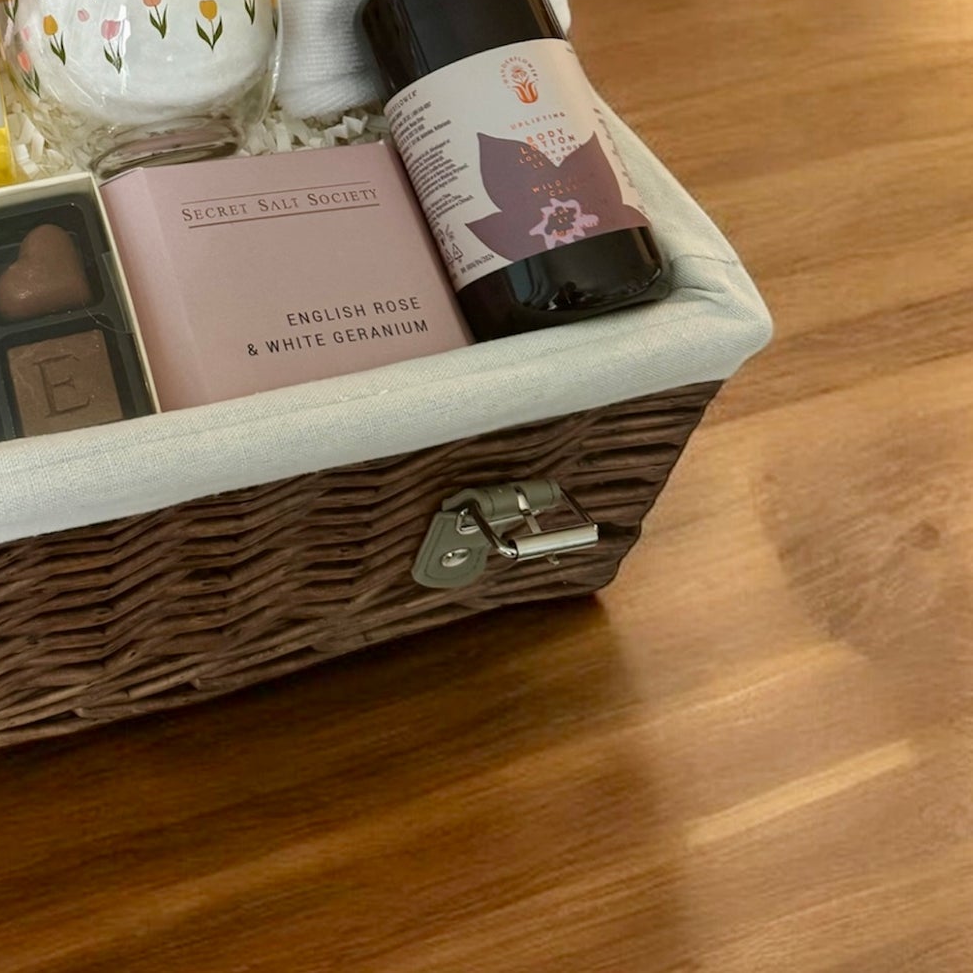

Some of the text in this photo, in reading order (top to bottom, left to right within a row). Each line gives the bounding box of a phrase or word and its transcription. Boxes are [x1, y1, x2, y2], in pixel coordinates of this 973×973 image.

[526, 127, 564, 144] BODY
[286, 296, 422, 326] ENGLISH ROSE
[247, 319, 429, 356] & WHITE GERANIUM
[33, 353, 90, 418] E
